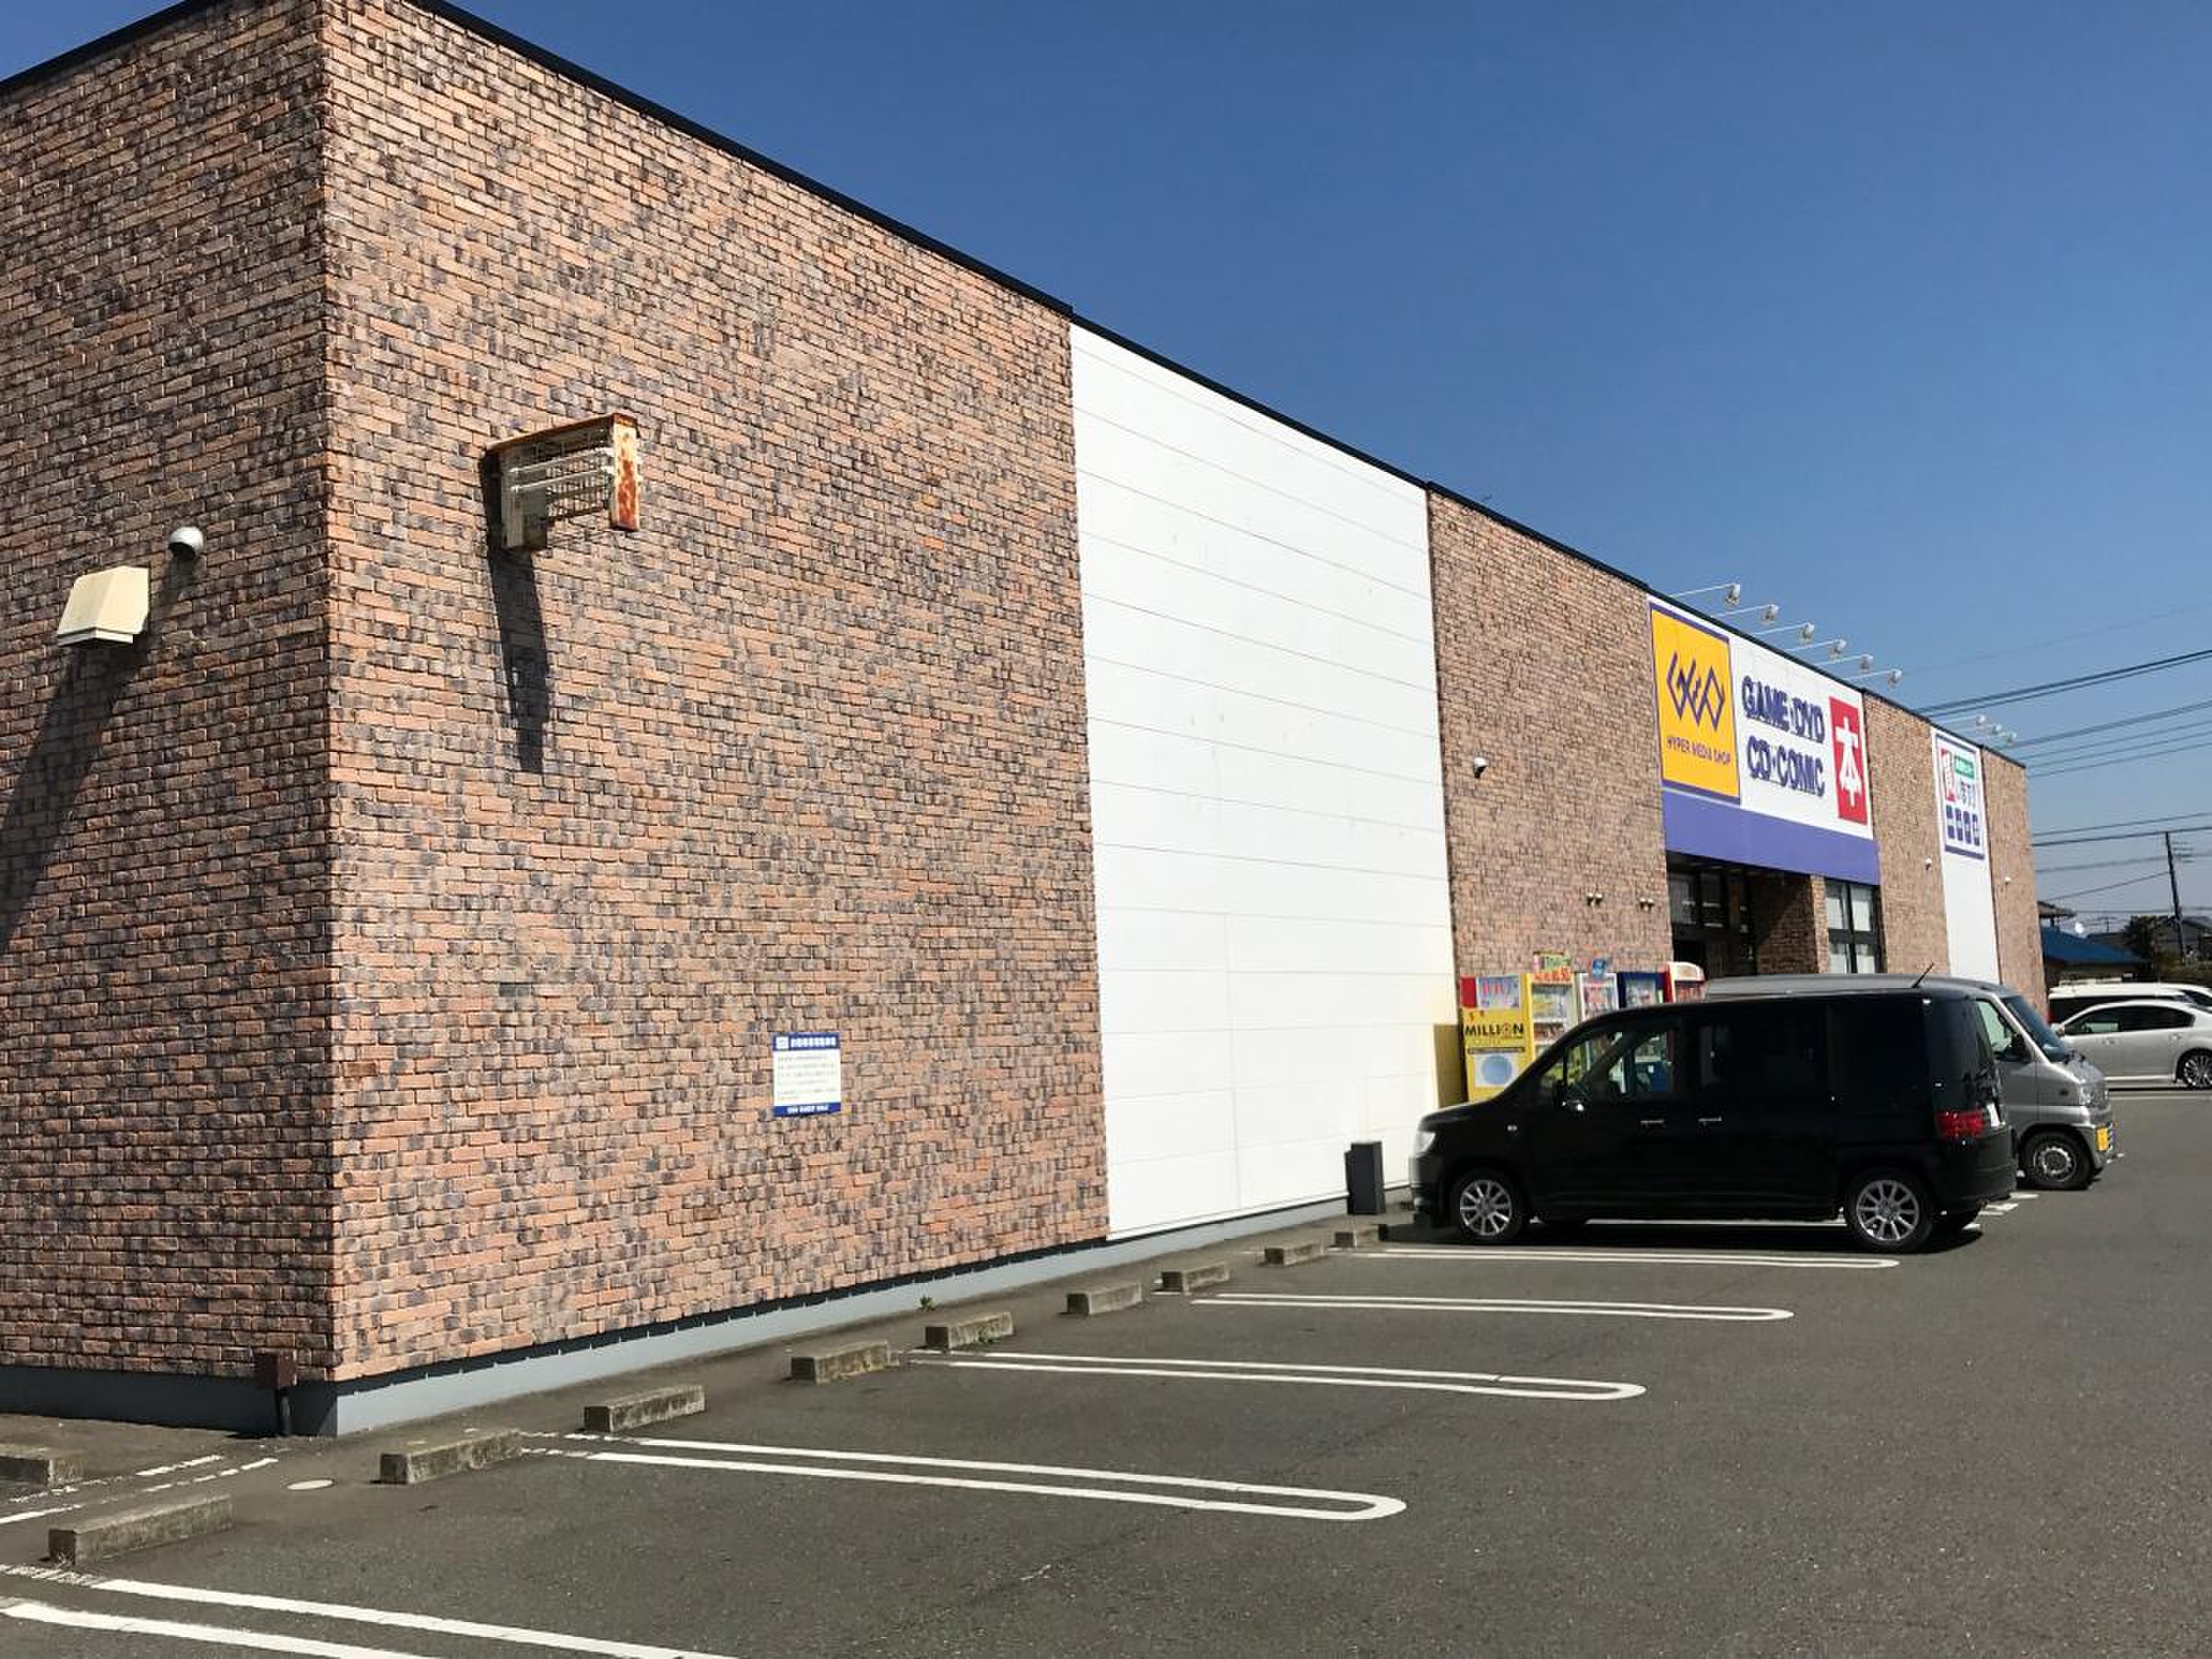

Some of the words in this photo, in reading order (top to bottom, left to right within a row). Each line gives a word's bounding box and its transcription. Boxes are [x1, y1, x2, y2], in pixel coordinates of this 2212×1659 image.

[1741, 676, 1789, 732] GAME
[1792, 698, 1825, 744] DVD
[1747, 735, 1771, 782] CD
[1777, 745, 1825, 796] COMIC
[1836, 717, 1862, 807] 本
[1465, 1023, 1524, 1037] MILLION
